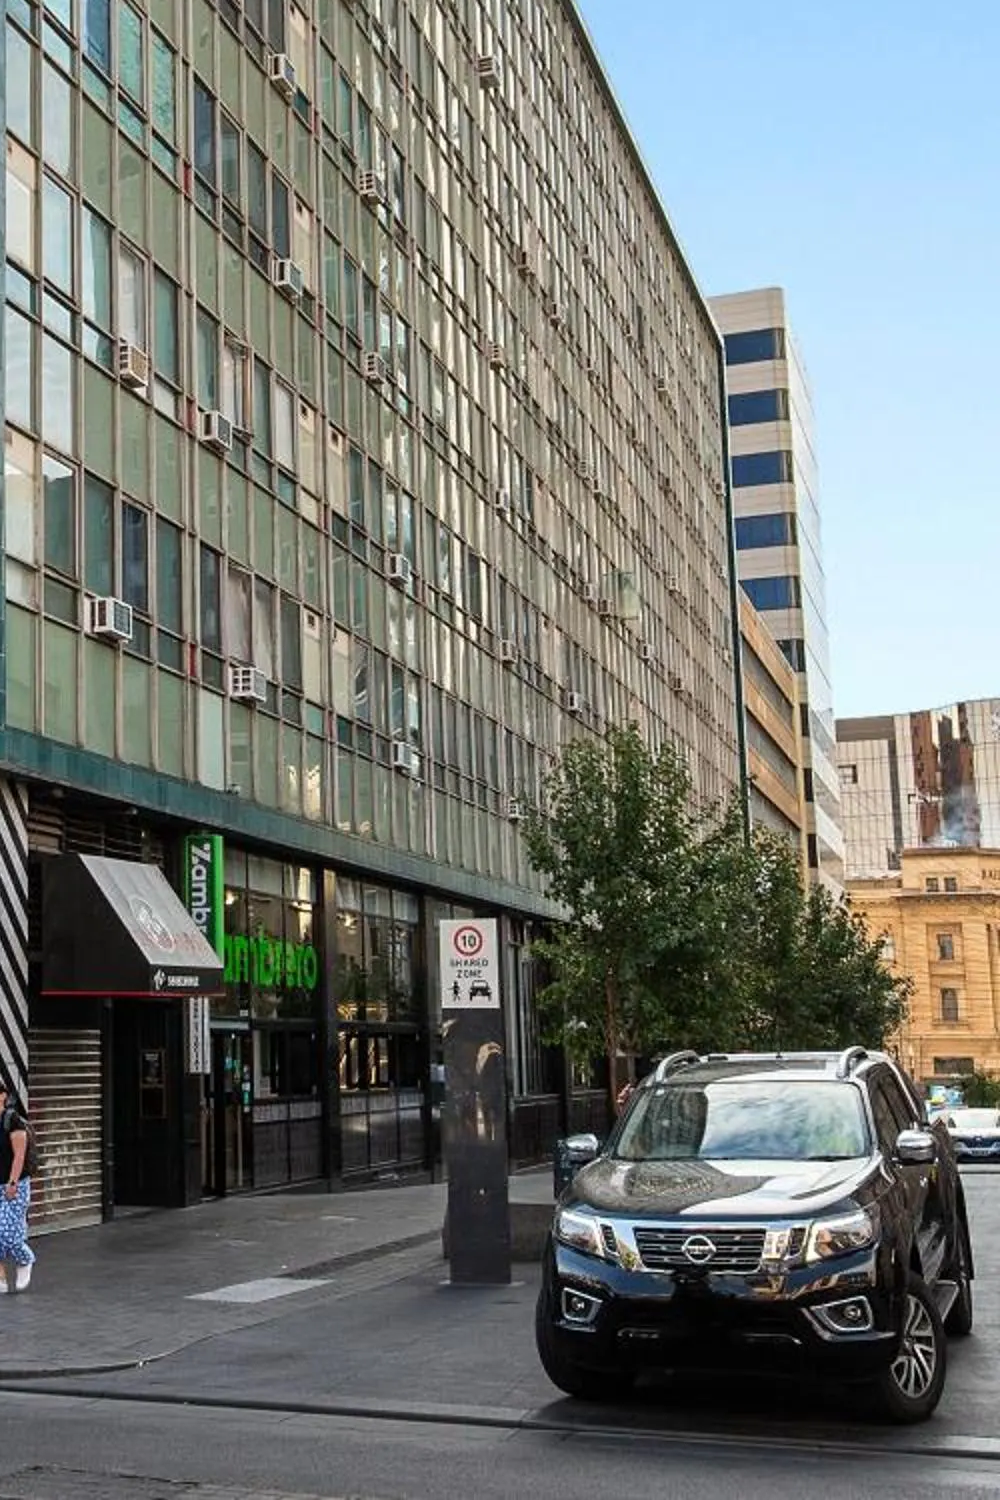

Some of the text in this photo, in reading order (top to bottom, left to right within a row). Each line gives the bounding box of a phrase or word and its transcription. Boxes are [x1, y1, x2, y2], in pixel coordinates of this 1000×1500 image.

[191, 843, 211, 934] Zambr
[462, 934, 477, 948] 10
[450, 959, 489, 968] SHARED
[456, 969, 482, 979] ZONE
